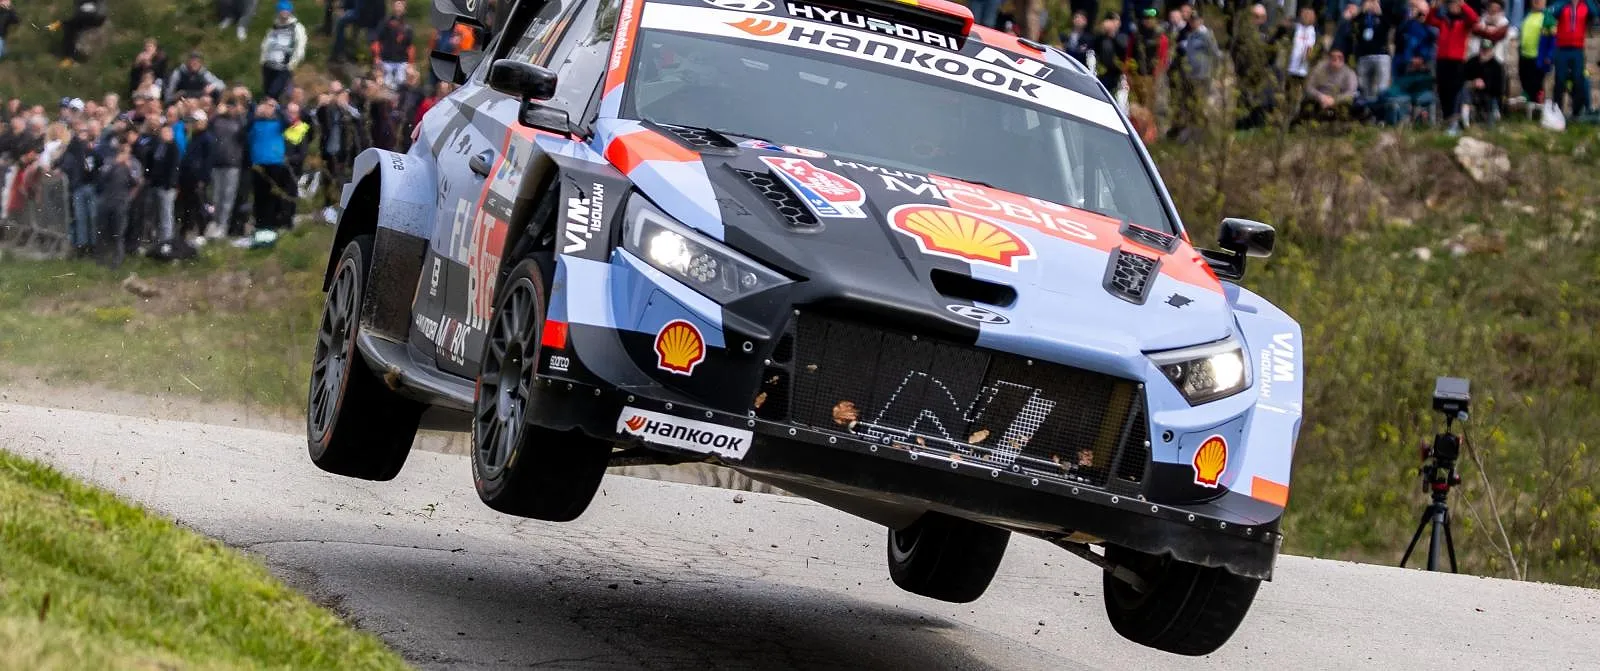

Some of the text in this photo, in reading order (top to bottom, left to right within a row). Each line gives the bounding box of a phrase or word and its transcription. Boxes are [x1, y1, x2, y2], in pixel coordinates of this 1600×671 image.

[788, 1, 959, 51] HYUNDAI
[591, 183, 604, 232] HYUNDAI
[877, 173, 1097, 241] MOBIS
[450, 198, 496, 267] FLAT
[1260, 348, 1271, 398] HYUNDAI
